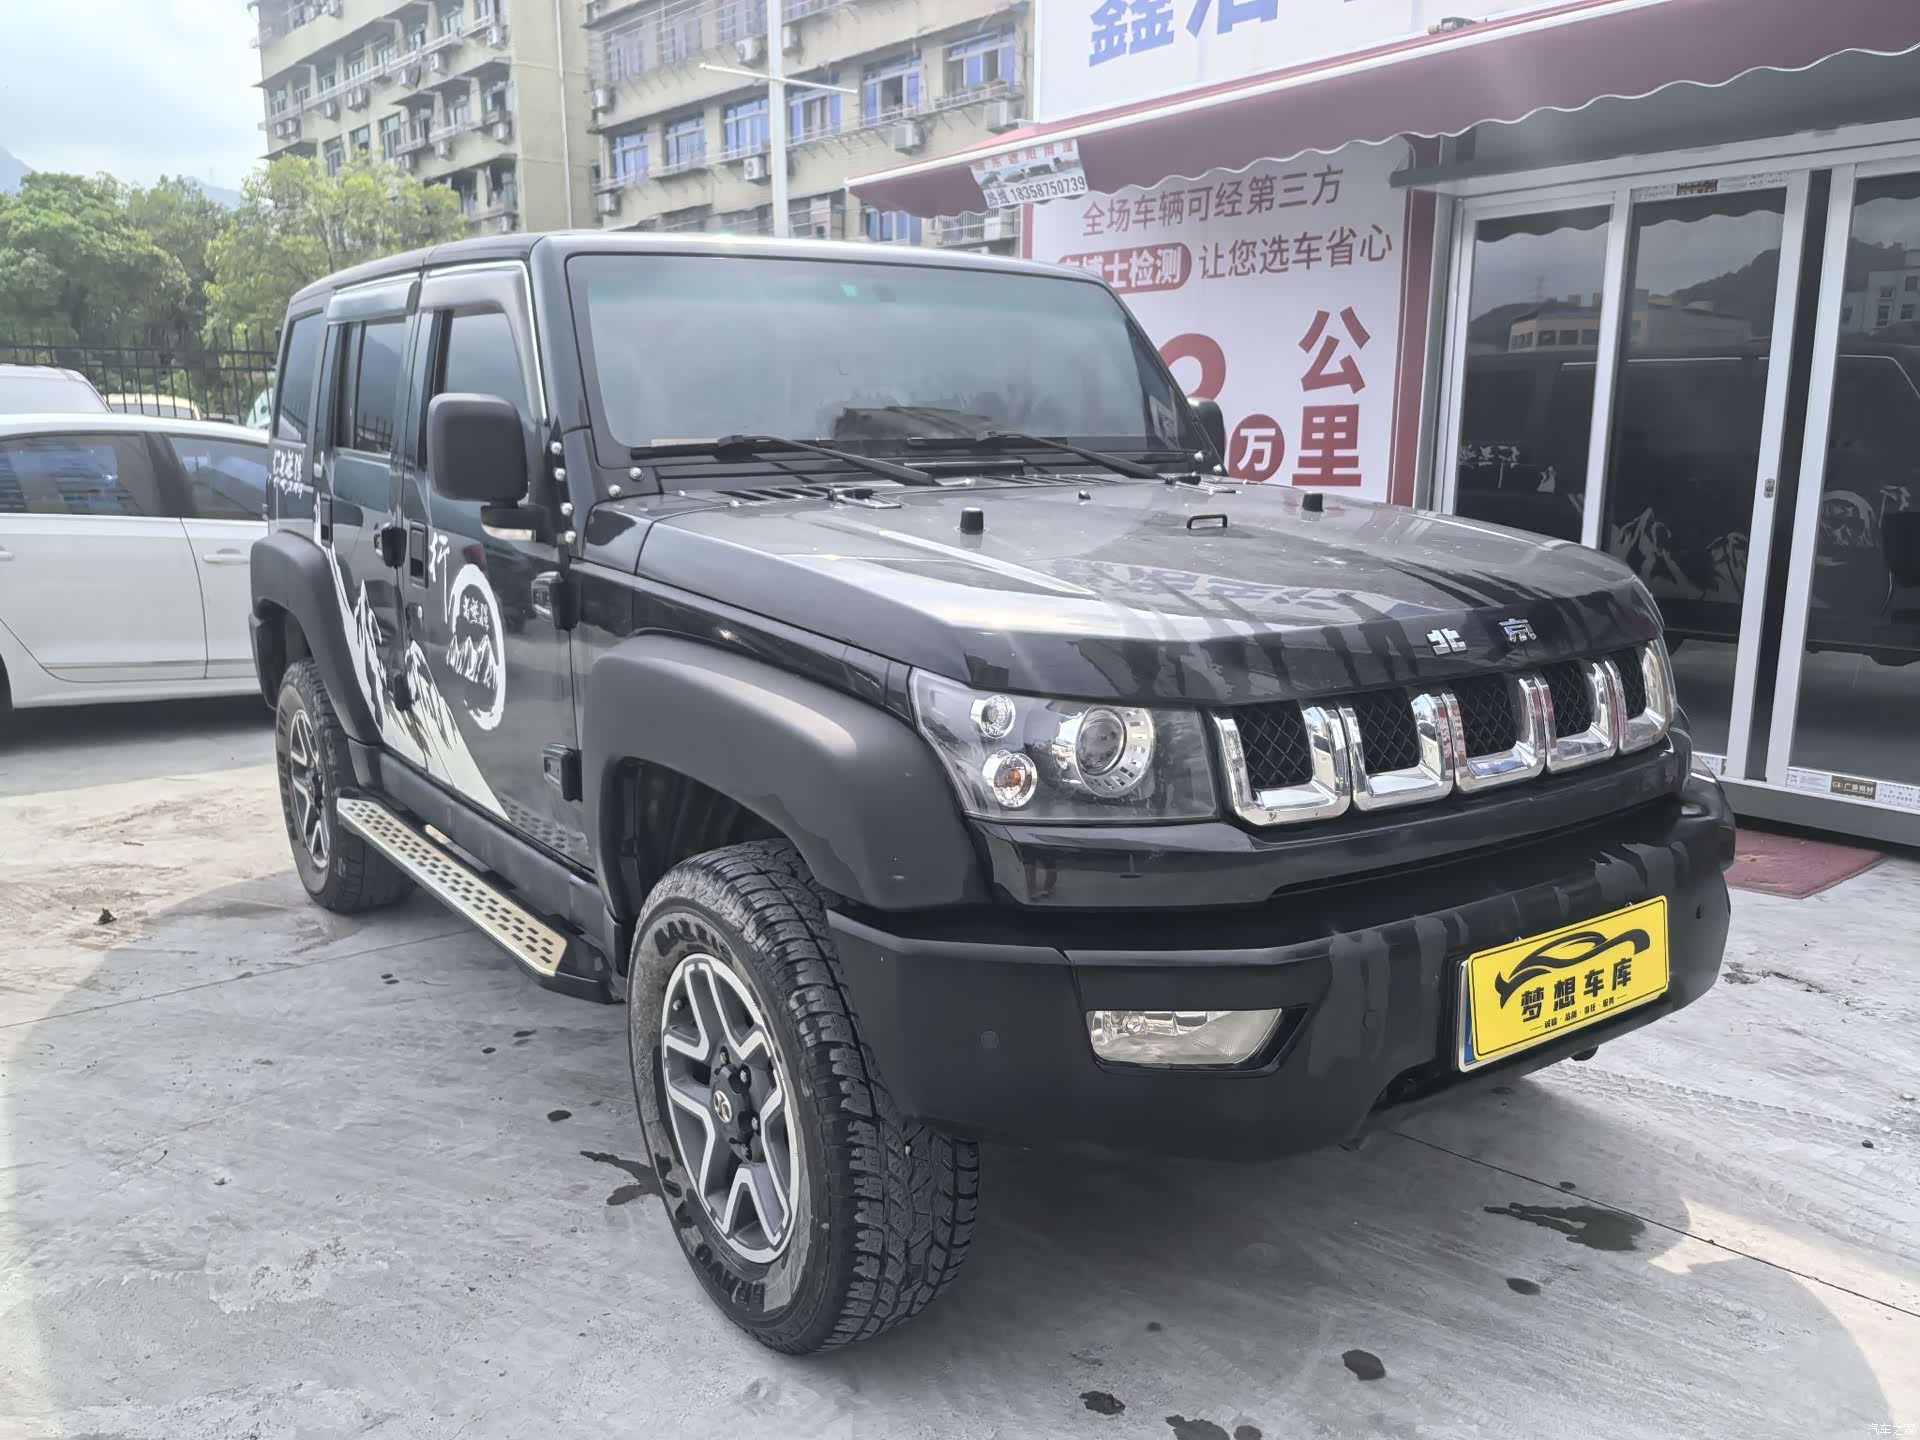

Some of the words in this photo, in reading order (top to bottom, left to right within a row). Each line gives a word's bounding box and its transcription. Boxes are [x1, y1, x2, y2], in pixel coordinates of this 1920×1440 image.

[1010, 176, 1086, 201] 18358750739
[1081, 165, 1345, 237] 全场车辆可经第三方
[1062, 246, 1183, 289] 士检测
[1198, 223, 1393, 281] 让您选车省心
[1291, 306, 1372, 487] 公里
[1236, 427, 1276, 472] 万
[1519, 957, 1632, 1022] 梦想车库
